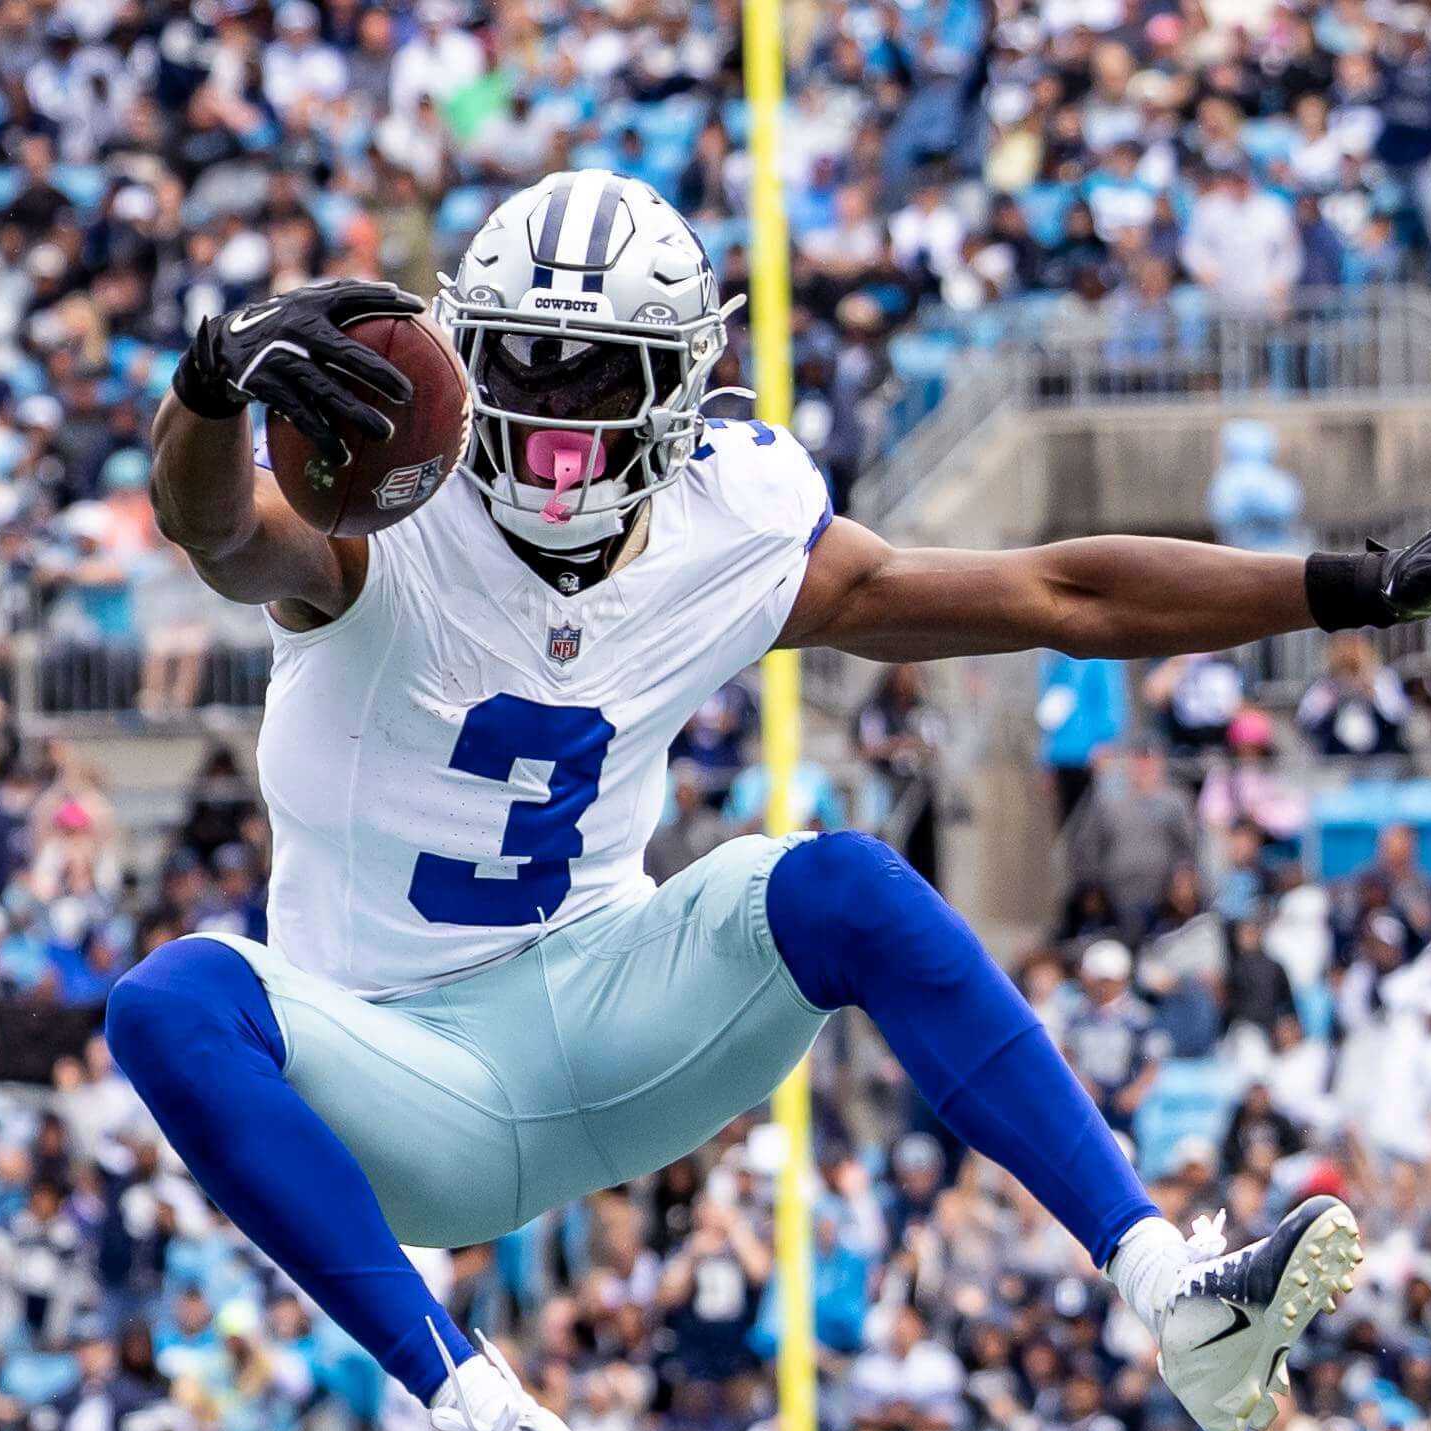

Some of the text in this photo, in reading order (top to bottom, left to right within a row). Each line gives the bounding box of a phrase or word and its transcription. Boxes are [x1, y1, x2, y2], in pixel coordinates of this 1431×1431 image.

[535, 298, 598, 313] COWBOYS
[552, 640, 577, 658] NFL
[407, 692, 617, 927] 3
